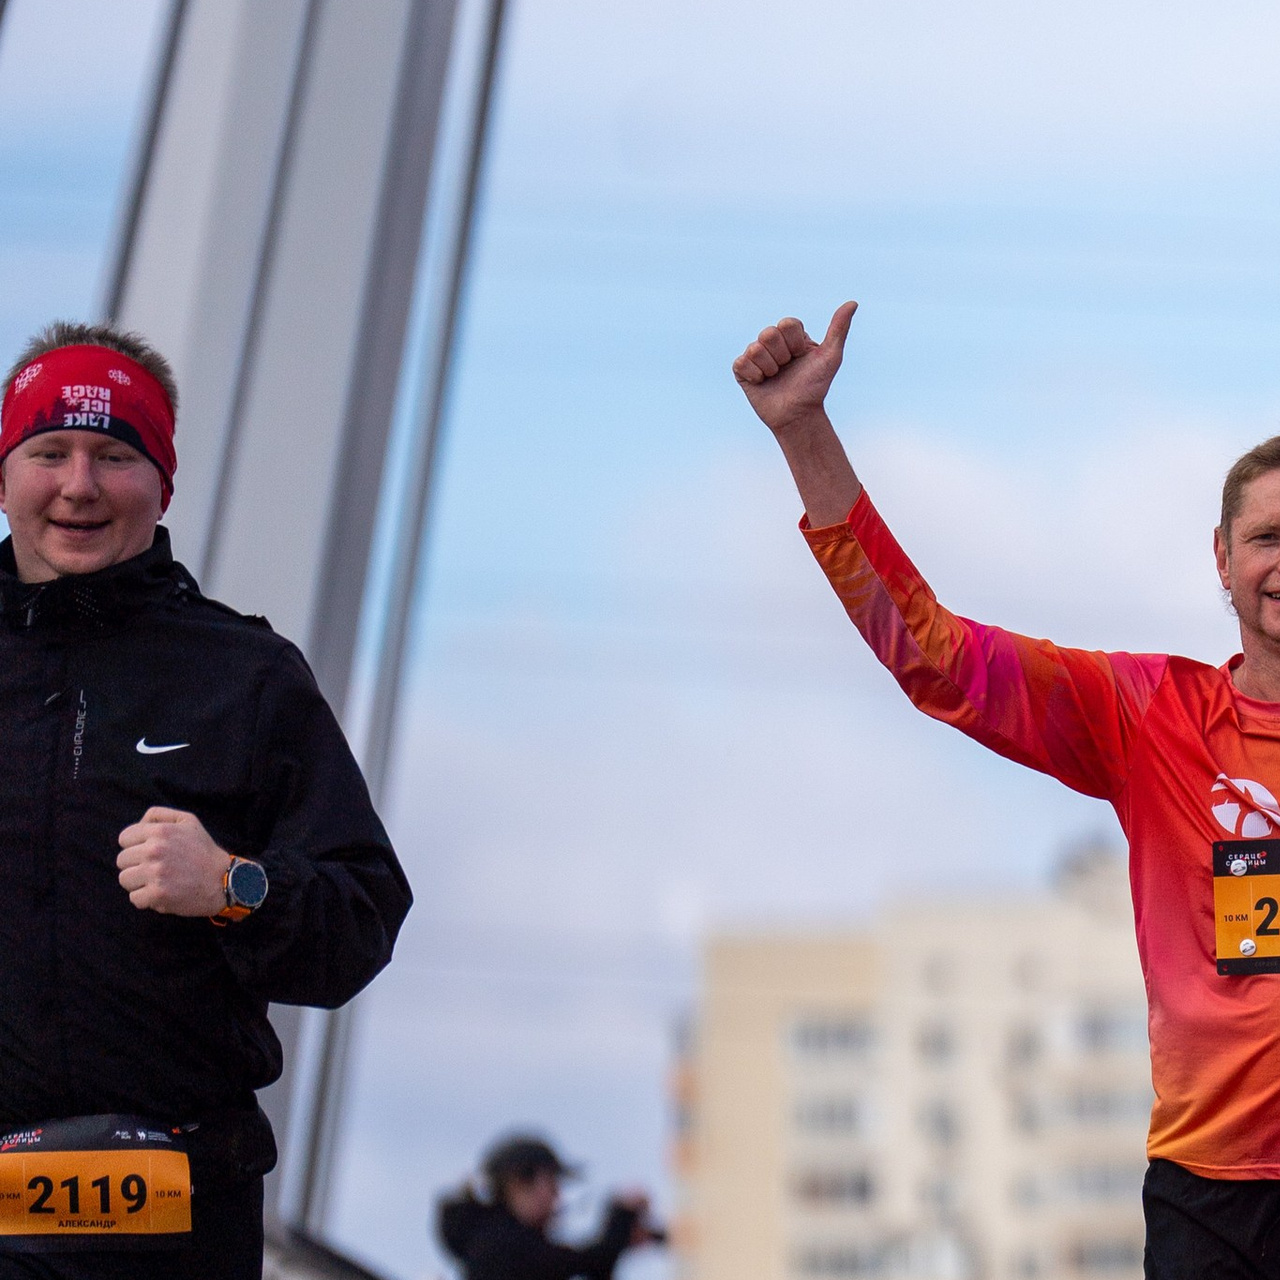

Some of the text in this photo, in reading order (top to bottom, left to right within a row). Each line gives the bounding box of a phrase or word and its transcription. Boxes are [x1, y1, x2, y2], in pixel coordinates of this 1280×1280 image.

[61, 385, 111, 401] RACE
[80, 398, 111, 415] ICE
[63, 412, 111, 429] LAKE
[1225, 859, 1267, 867] СИЦЫ
[1224, 914, 1234, 922] 10
[27, 1173, 148, 1214] 2119
[155, 1190, 165, 1199] 10
[58, 1220, 117, 1229] АЛЕКСАНДР
